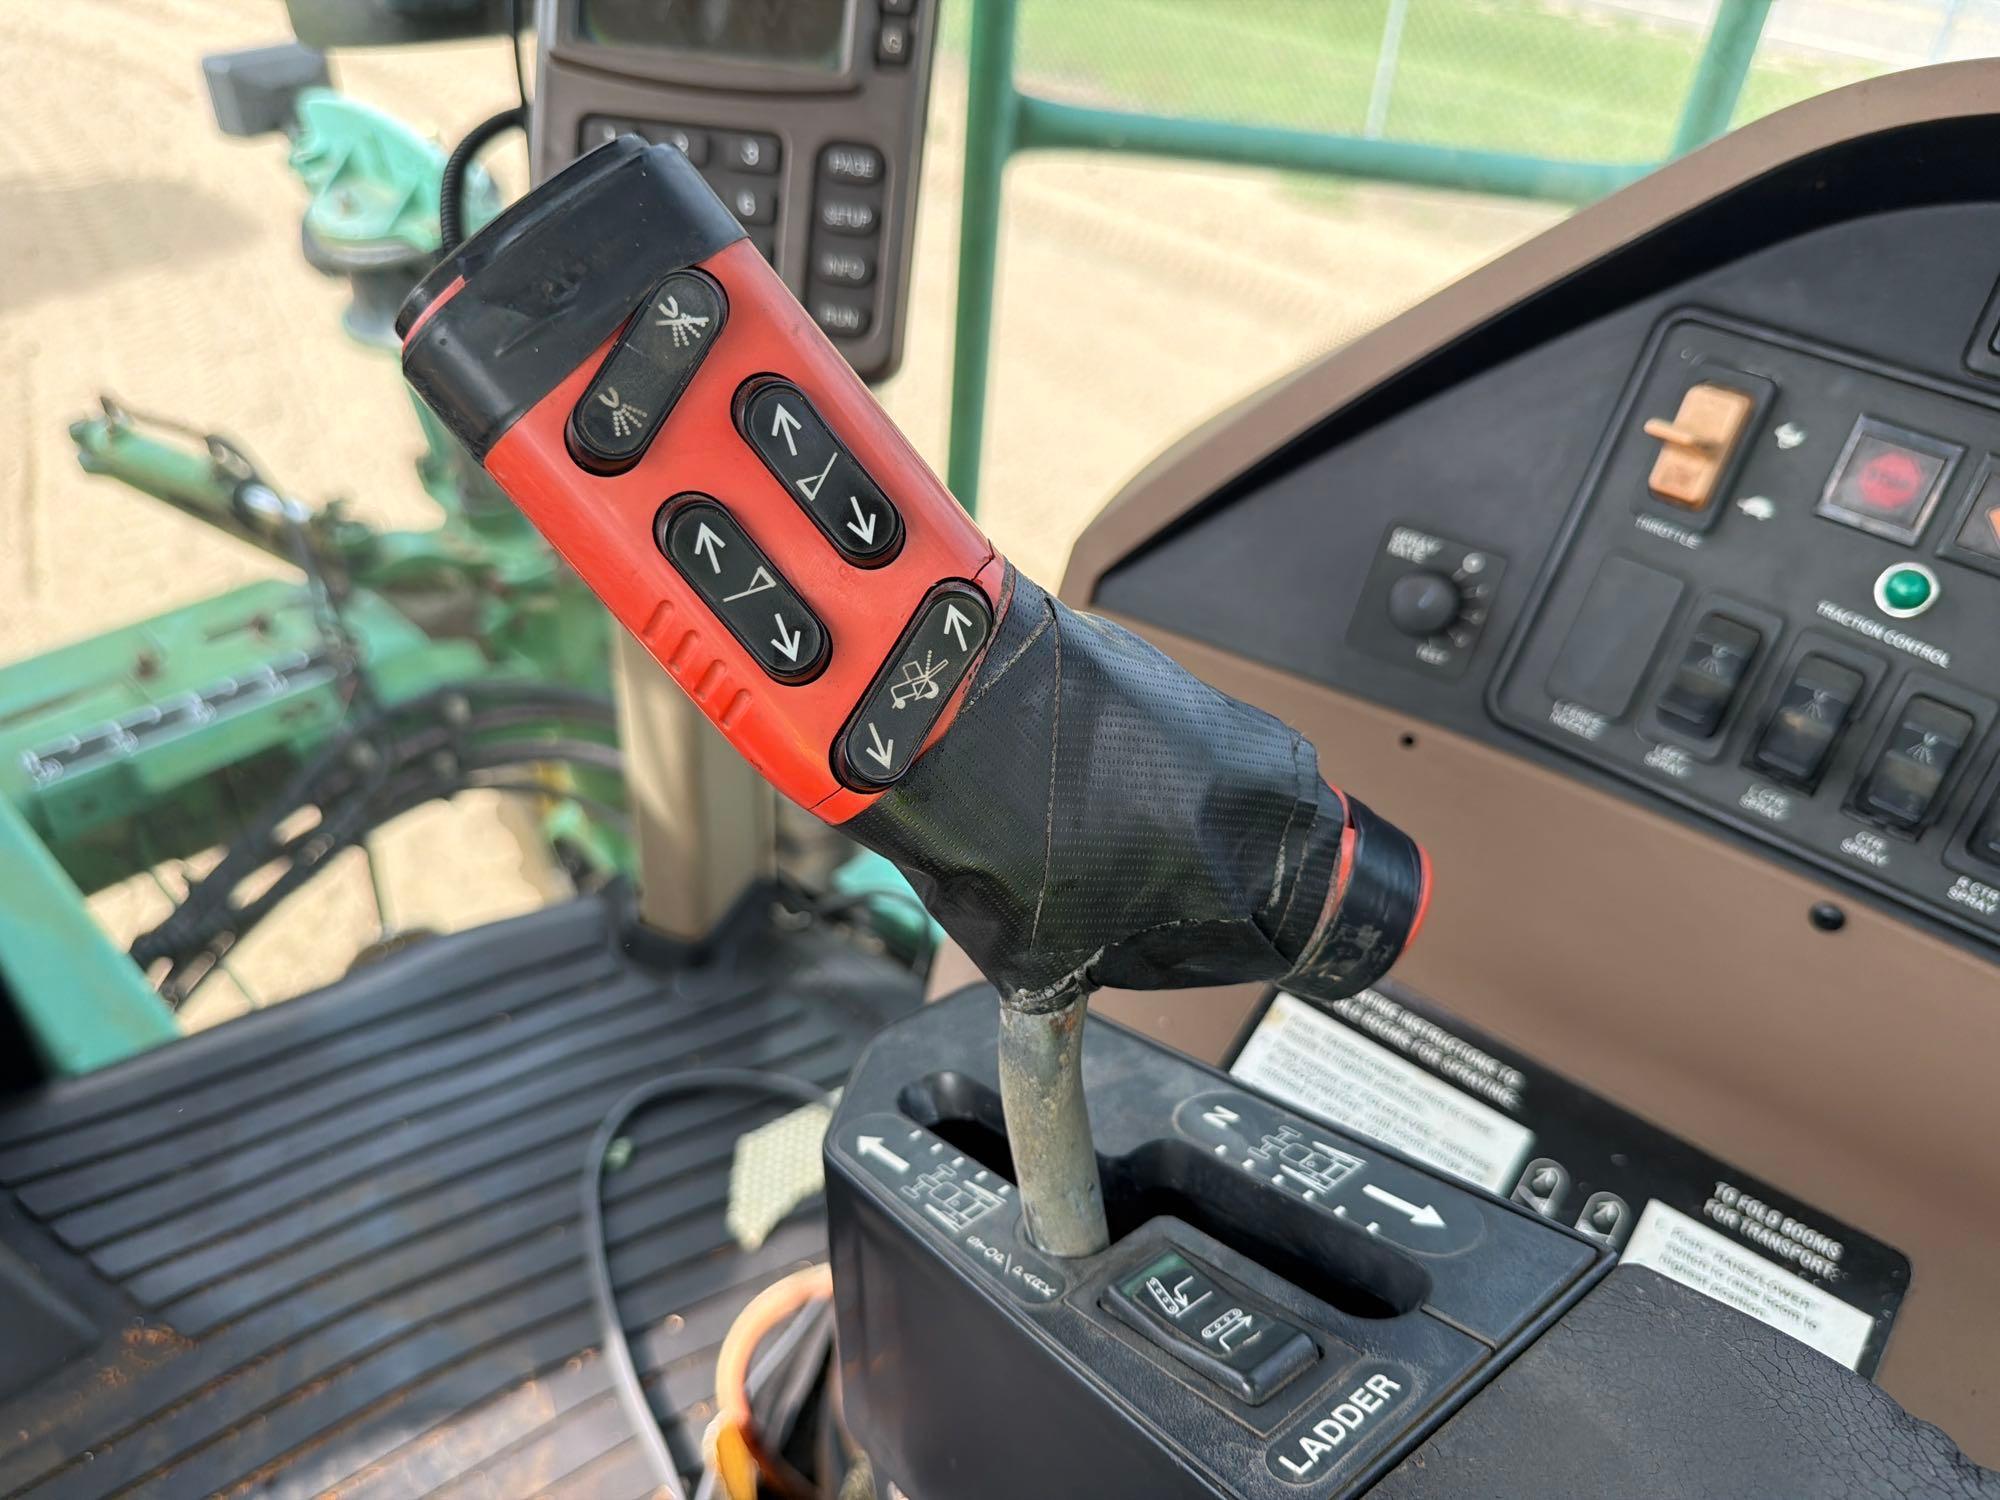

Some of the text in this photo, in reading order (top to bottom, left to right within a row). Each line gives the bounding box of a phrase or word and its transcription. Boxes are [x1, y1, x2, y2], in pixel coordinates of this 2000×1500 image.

[823, 203, 873, 228] SETUP
[1634, 514, 1699, 550] THROTTLE
[1816, 600, 1951, 669] TRACTION CONTROL
[1643, 752, 1689, 778] SPRAY
[1738, 794, 1785, 821] SPRAY
[1840, 838, 1889, 867] SPRAY
[1947, 886, 1998, 915] SPRAY
[1361, 1010, 1414, 1050] BOOMS
[1411, 1038, 1443, 1070] FOR
[1441, 1055, 1523, 1112] SPRAYING
[1398, 1010, 1501, 1077] INSTRUCTIONS
[1498, 1064, 1526, 1090] TO
[1202, 1105, 1240, 1129] N
[1703, 1198, 1839, 1280] FOR TRANSPORT
[1714, 1181, 1844, 1262] TO FOLD BOOMS
[1278, 1373, 1401, 1475] LADDER
